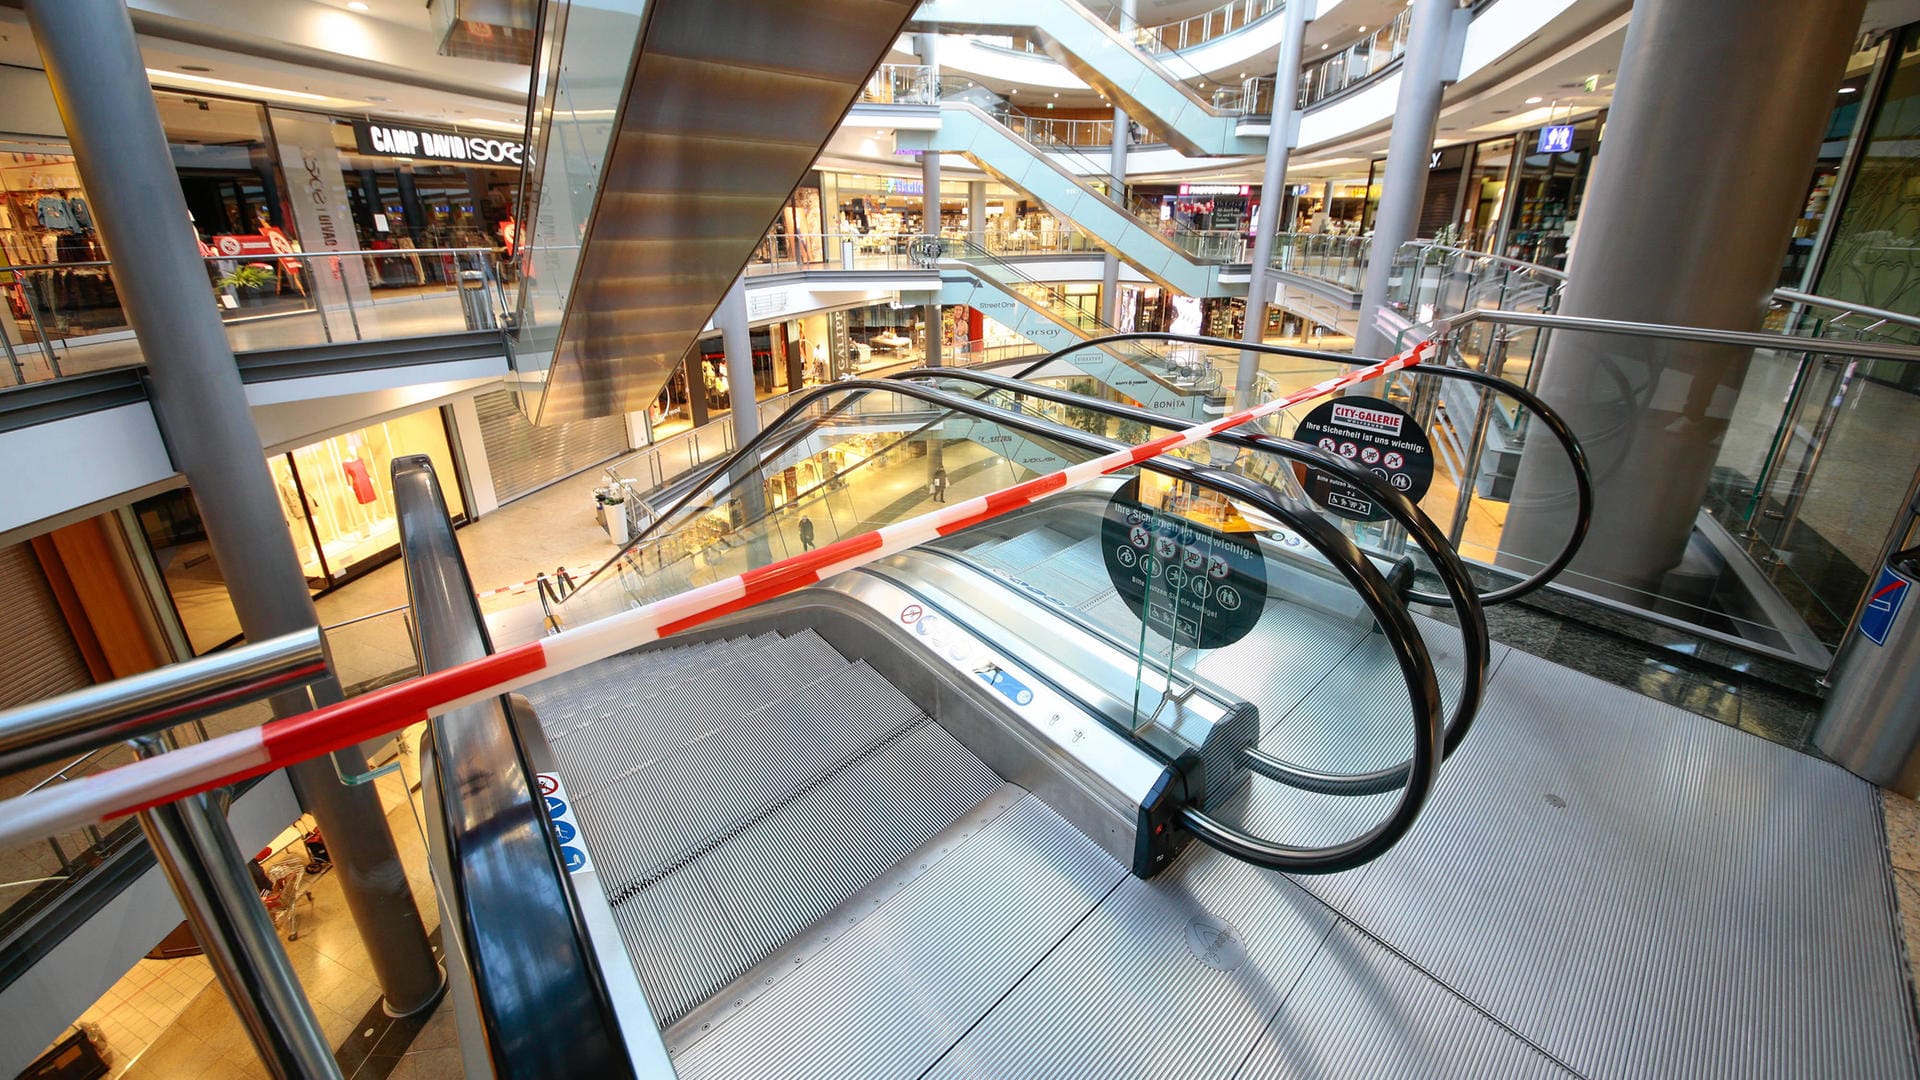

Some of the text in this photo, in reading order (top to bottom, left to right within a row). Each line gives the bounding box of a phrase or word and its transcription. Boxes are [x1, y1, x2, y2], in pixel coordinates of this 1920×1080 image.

[370, 126, 418, 155] CAMP
[422, 132, 466, 159] DAVID
[1026, 328, 1061, 338] orsay
[1335, 406, 1401, 427] CITY-GALERIE
[1306, 421, 1425, 454] Ihre Sicherheit ist uns wichtig:
[1114, 502, 1131, 516] Ihre
[1195, 532, 1212, 545] uns
[1212, 536, 1254, 560] wichtig:
